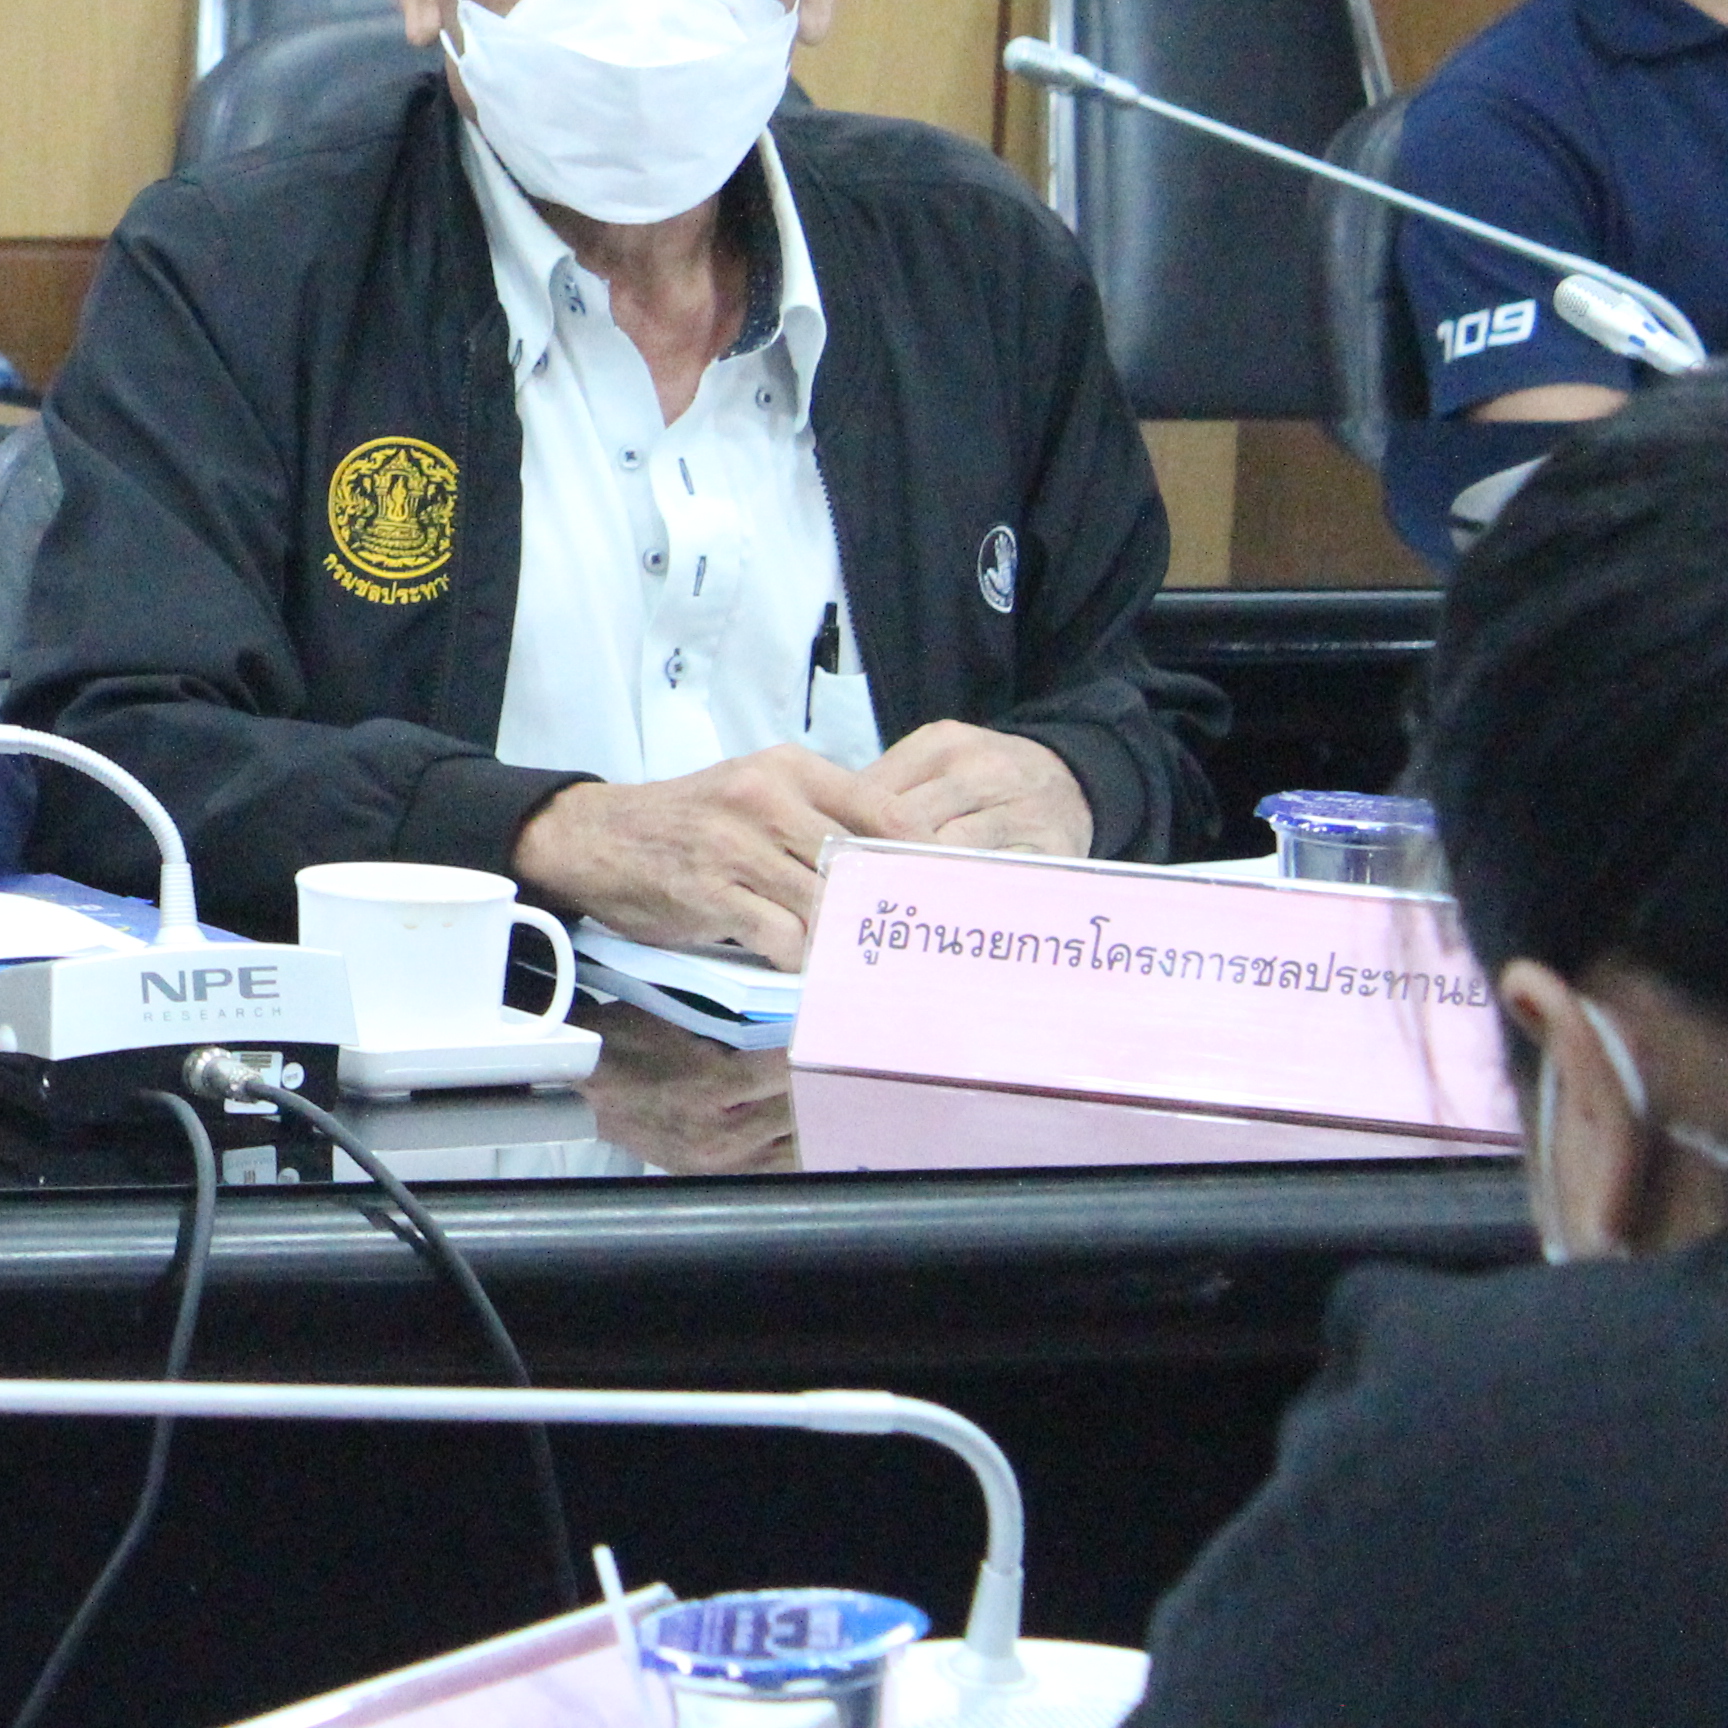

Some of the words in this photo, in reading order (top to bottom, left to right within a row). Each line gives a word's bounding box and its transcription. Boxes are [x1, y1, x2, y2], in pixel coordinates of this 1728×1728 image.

[1436, 298, 1537, 363] 109
[322, 552, 450, 605] กรมชลประทา
[140, 966, 280, 1003] NPE
[144, 1005, 284, 1023] RESEARCH
